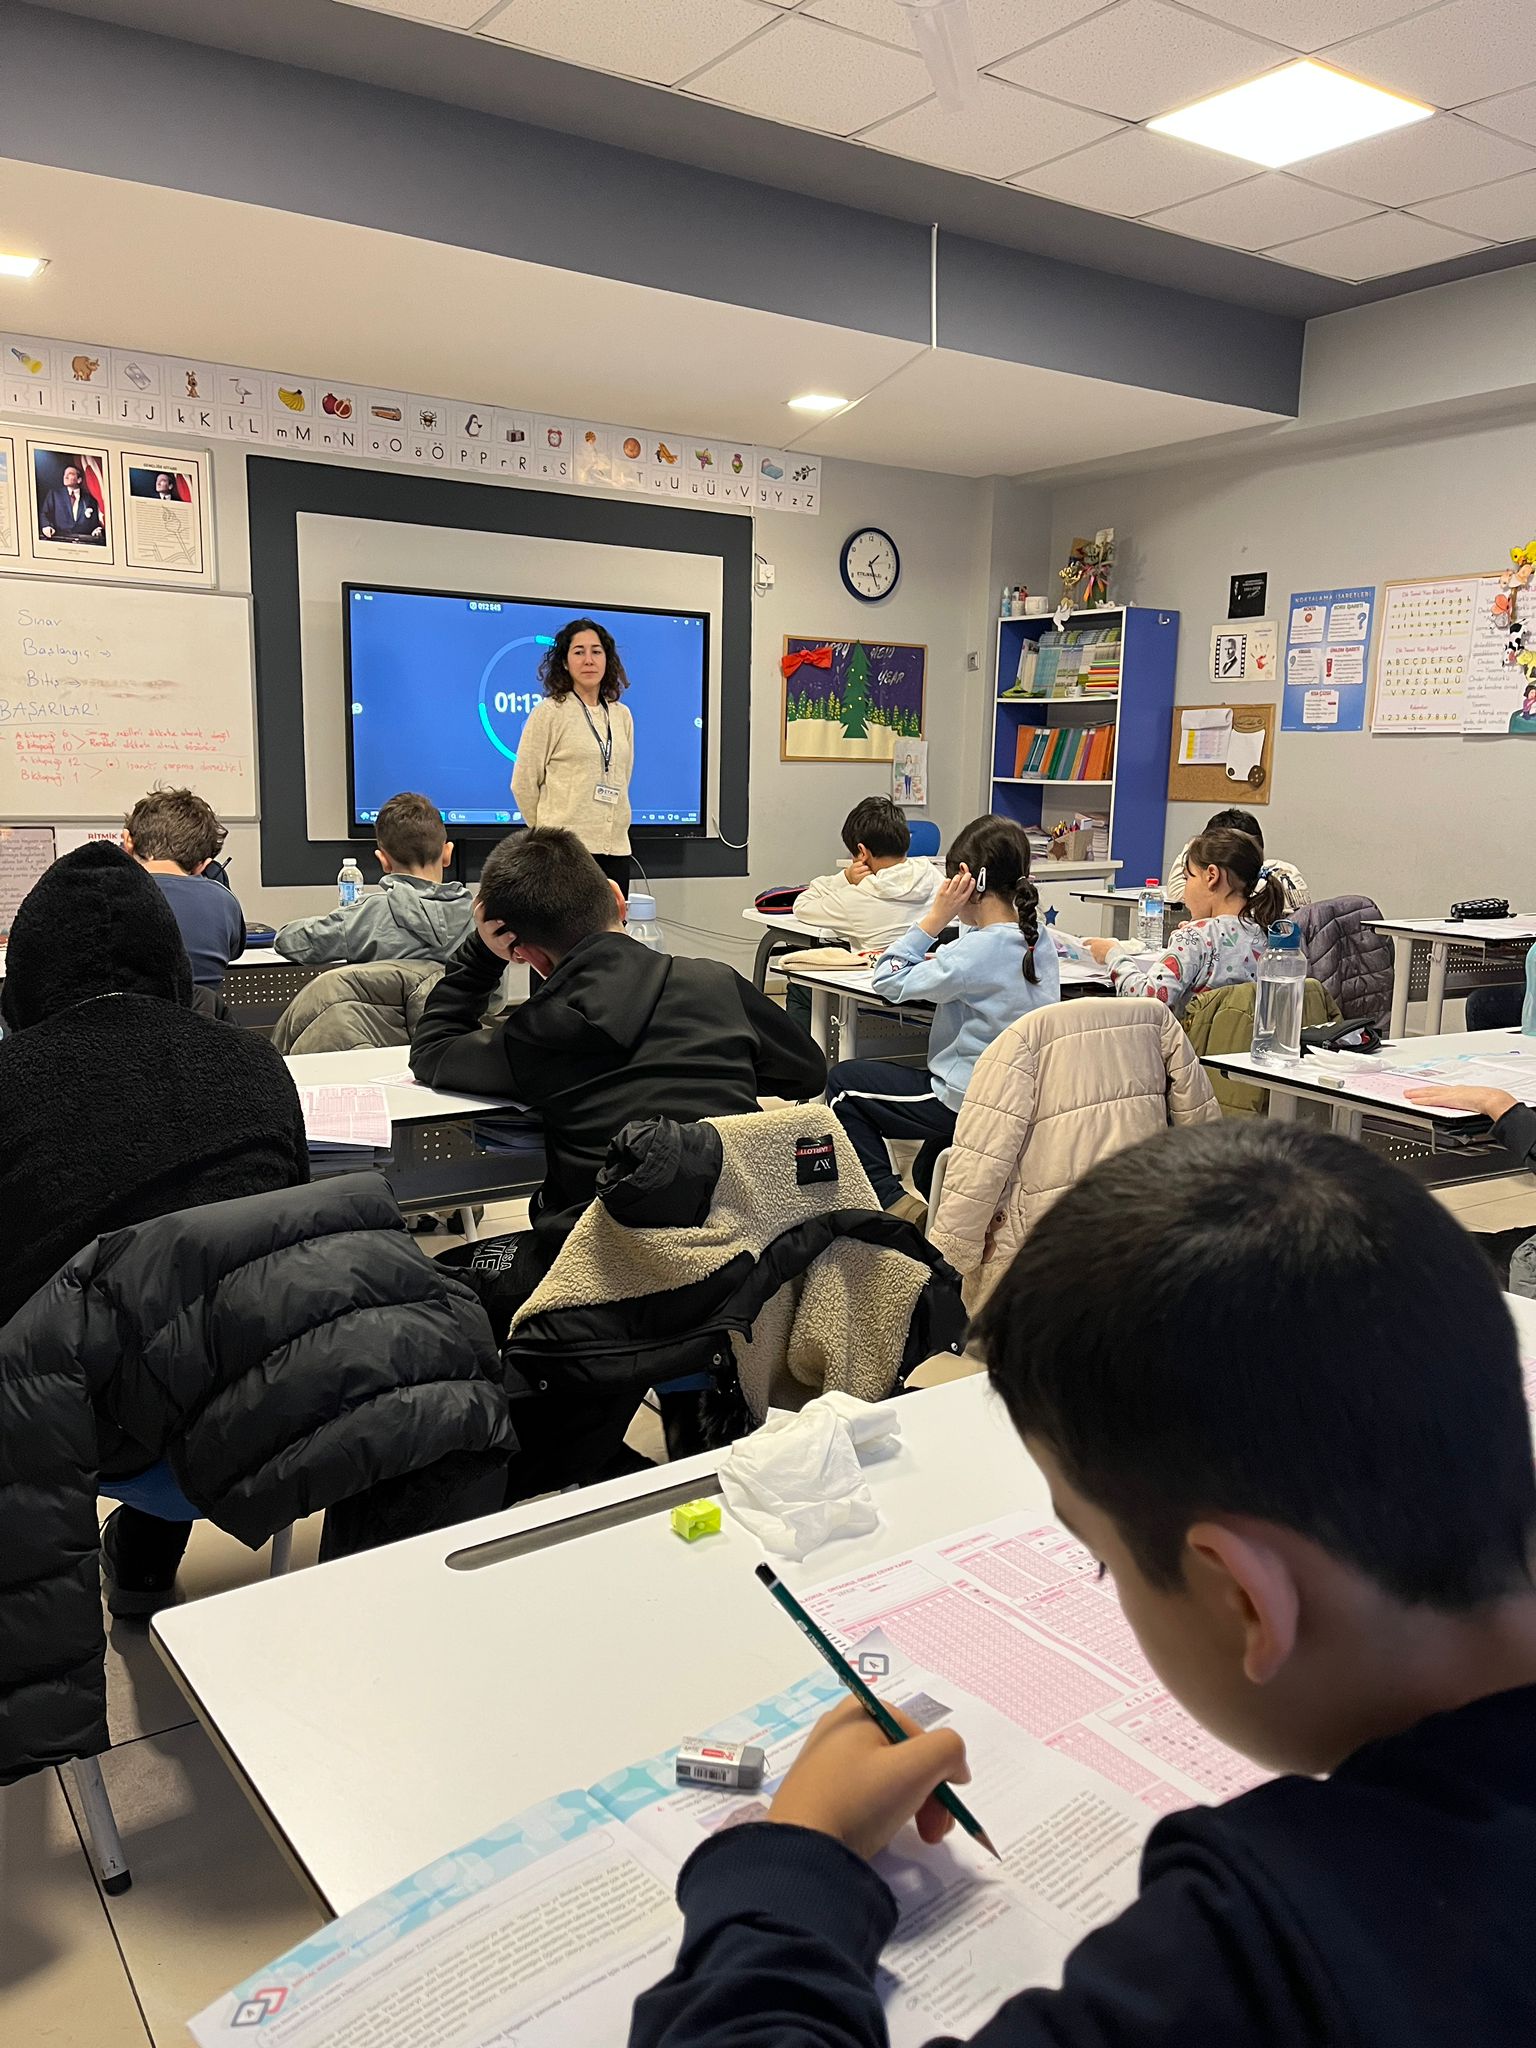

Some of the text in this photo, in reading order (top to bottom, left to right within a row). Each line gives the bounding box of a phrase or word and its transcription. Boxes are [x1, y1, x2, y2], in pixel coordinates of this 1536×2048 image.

[122, 400, 128, 417] j
[146, 406, 154, 419] J
[178, 409, 184, 423] k
[200, 412, 210, 426] K
[249, 418, 258, 433] L
[277, 429, 287, 437] m
[296, 426, 310, 441] M
[324, 435, 331, 443] n
[343, 432, 354, 446] N
[390, 439, 402, 452] O
[415, 447, 422, 457] ö
[432, 442, 444, 459] Ö
[480, 452, 487, 464] P
[519, 457, 526, 470] R
[560, 463, 566, 475] S
[670, 477, 679, 489] U
[692, 483, 698, 493] ü
[706, 480, 715, 495] Ü
[740, 486, 749, 497] V
[775, 491, 782, 502] Y
[806, 495, 813, 506] Z
[1457, 655, 1463, 663] Ğ
[63, 742, 72, 752] 10
[69, 757, 81, 766] 12
[21, 769, 29, 780] B
